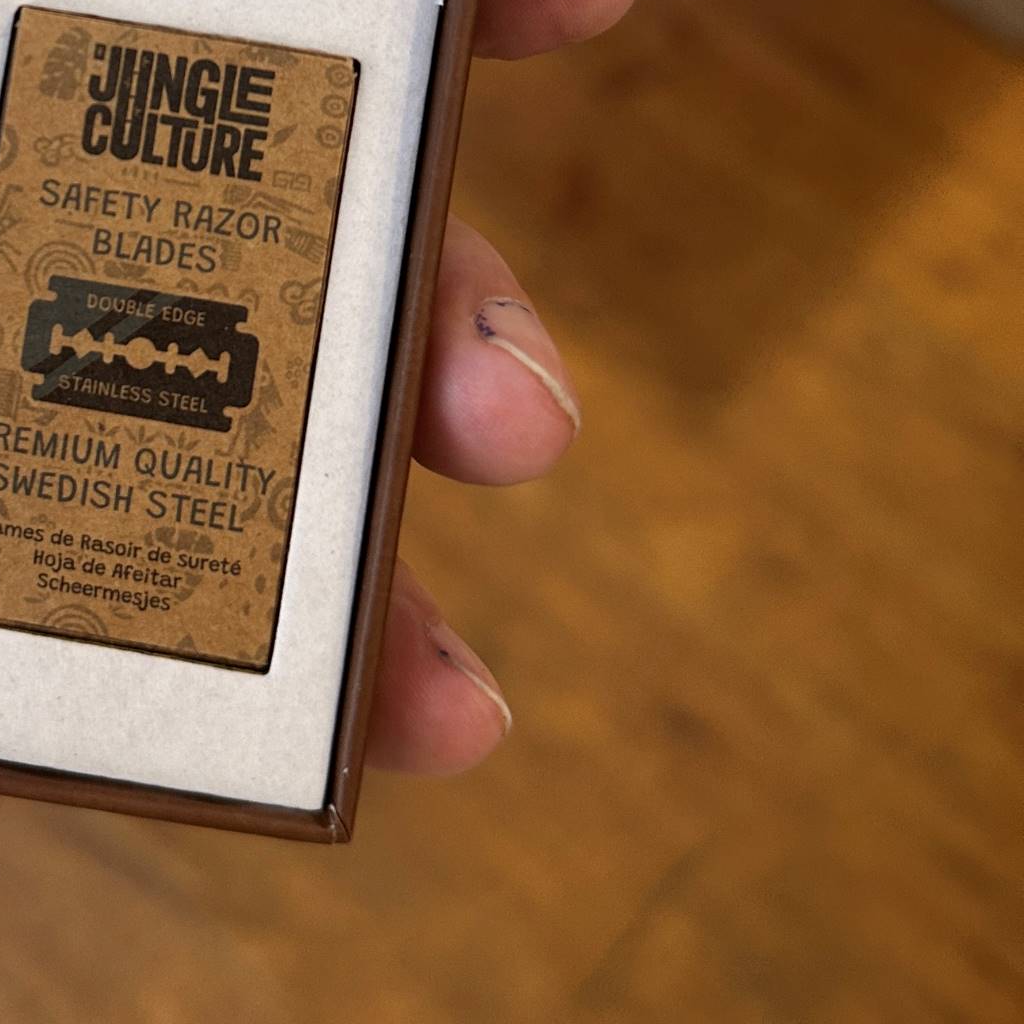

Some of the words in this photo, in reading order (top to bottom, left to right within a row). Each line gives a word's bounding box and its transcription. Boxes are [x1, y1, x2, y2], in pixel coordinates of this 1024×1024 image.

[87, 43, 275, 127] JUNGLE
[81, 103, 267, 182] CULTURE
[39, 179, 161, 223] SAFETY
[172, 200, 282, 244] RAZOR
[92, 228, 217, 274] BLADES
[86, 293, 155, 320] DOUBLE
[161, 306, 206, 326] EDGE
[58, 374, 152, 405] STAINLESS
[158, 390, 208, 414] STEEL
[134, 447, 276, 495] QUALITY
[146, 490, 244, 533] STEEL
[51, 529, 74, 547] de
[81, 534, 143, 560] Rasoir
[148, 546, 171, 564] de
[33, 549, 76, 572] Hoja
[82, 558, 106, 576] de
[112, 563, 182, 589] Afeitar
[37, 572, 171, 611] Scheermesjes
